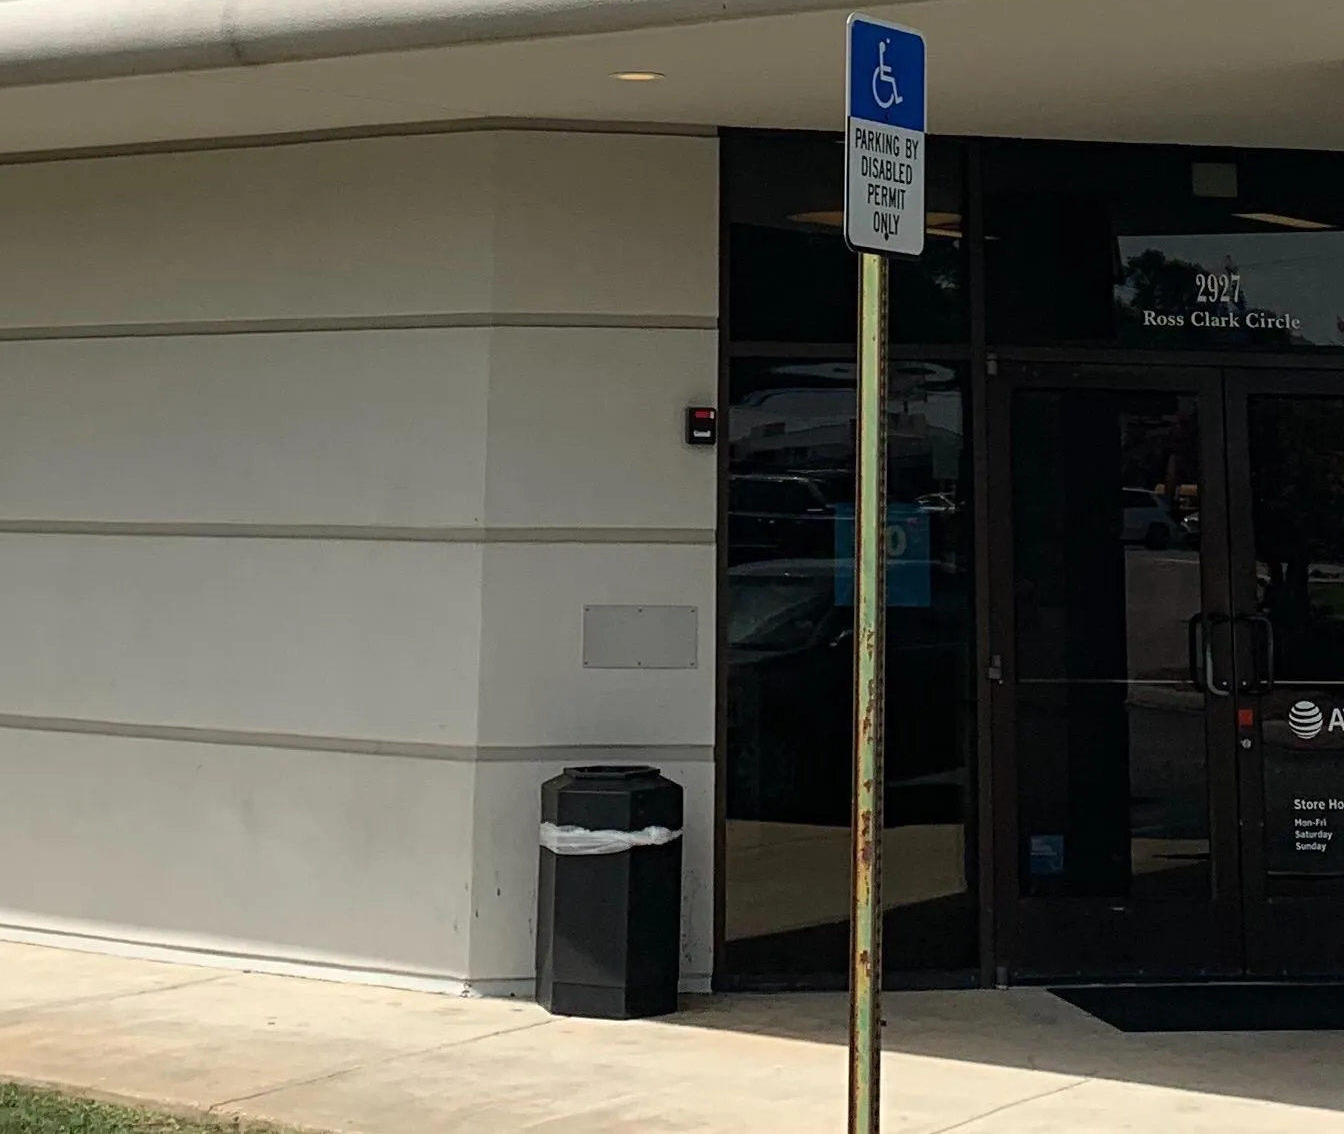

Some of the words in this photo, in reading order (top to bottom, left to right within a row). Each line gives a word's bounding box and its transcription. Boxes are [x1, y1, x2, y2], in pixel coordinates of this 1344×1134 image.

[855, 127, 900, 158] PARKING
[905, 138, 919, 161] BY
[861, 155, 913, 185] DISABLED
[867, 183, 906, 210] PERMIT
[873, 211, 900, 236] ONLY
[1195, 273, 1241, 303] 2927
[1143, 310, 1185, 328] Ross
[1190, 310, 1240, 329] Clark
[1245, 312, 1301, 330] Circle
[1294, 798, 1326, 810] Store
[1294, 818, 1327, 827] Mon-Fri
[1294, 830, 1333, 841] Saturday
[1295, 842, 1327, 852] Sunday
